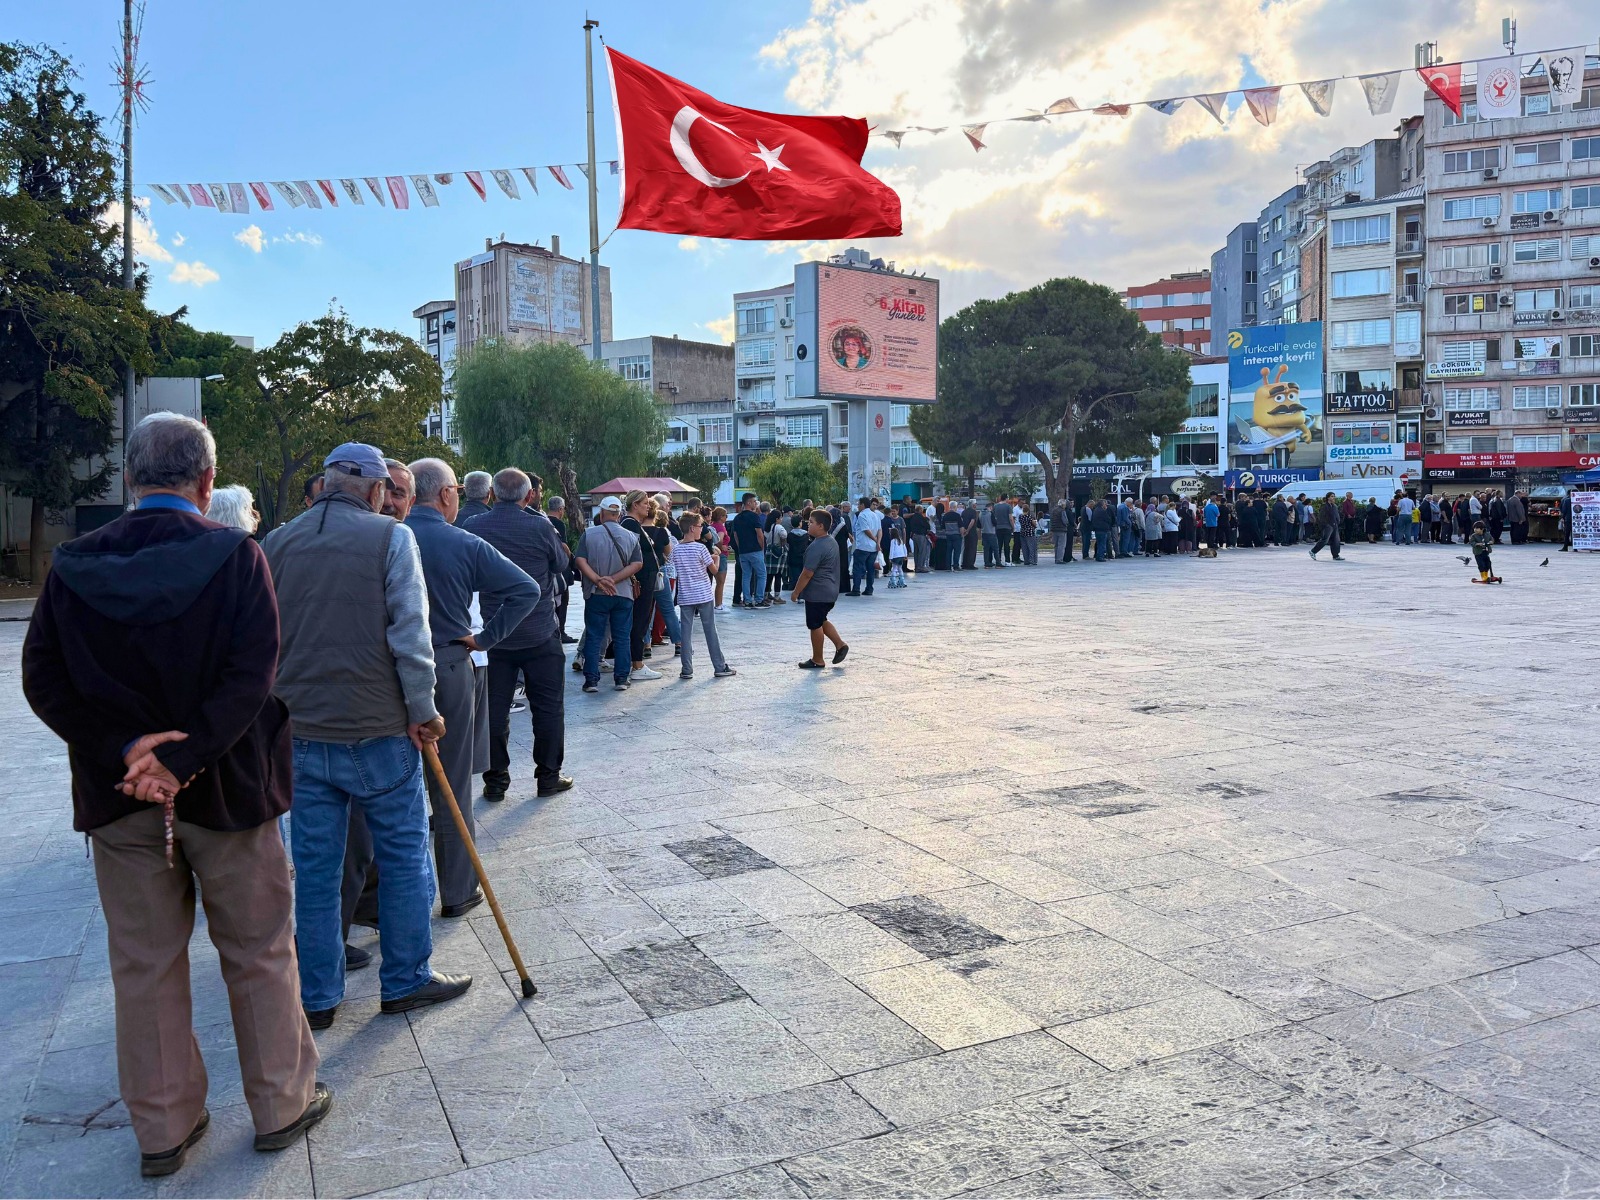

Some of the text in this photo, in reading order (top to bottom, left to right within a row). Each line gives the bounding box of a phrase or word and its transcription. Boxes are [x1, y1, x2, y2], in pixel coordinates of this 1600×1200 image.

[1515, 313, 1546, 321] AVUKAT
[1243, 340, 1317, 355] Turkcell'le evde
[1243, 351, 1315, 366] internet keyfi!
[1430, 366, 1482, 375] GAYRİMENKUL
[1335, 393, 1386, 408] TATTOO
[1330, 444, 1393, 459] gezinomi
[1072, 463, 1144, 474] EGE PLUS GÜZELLİK
[1351, 463, 1394, 479] EVREN
[1429, 469, 1455, 477] GİZEM
[1258, 473, 1309, 483] TURKCELL
